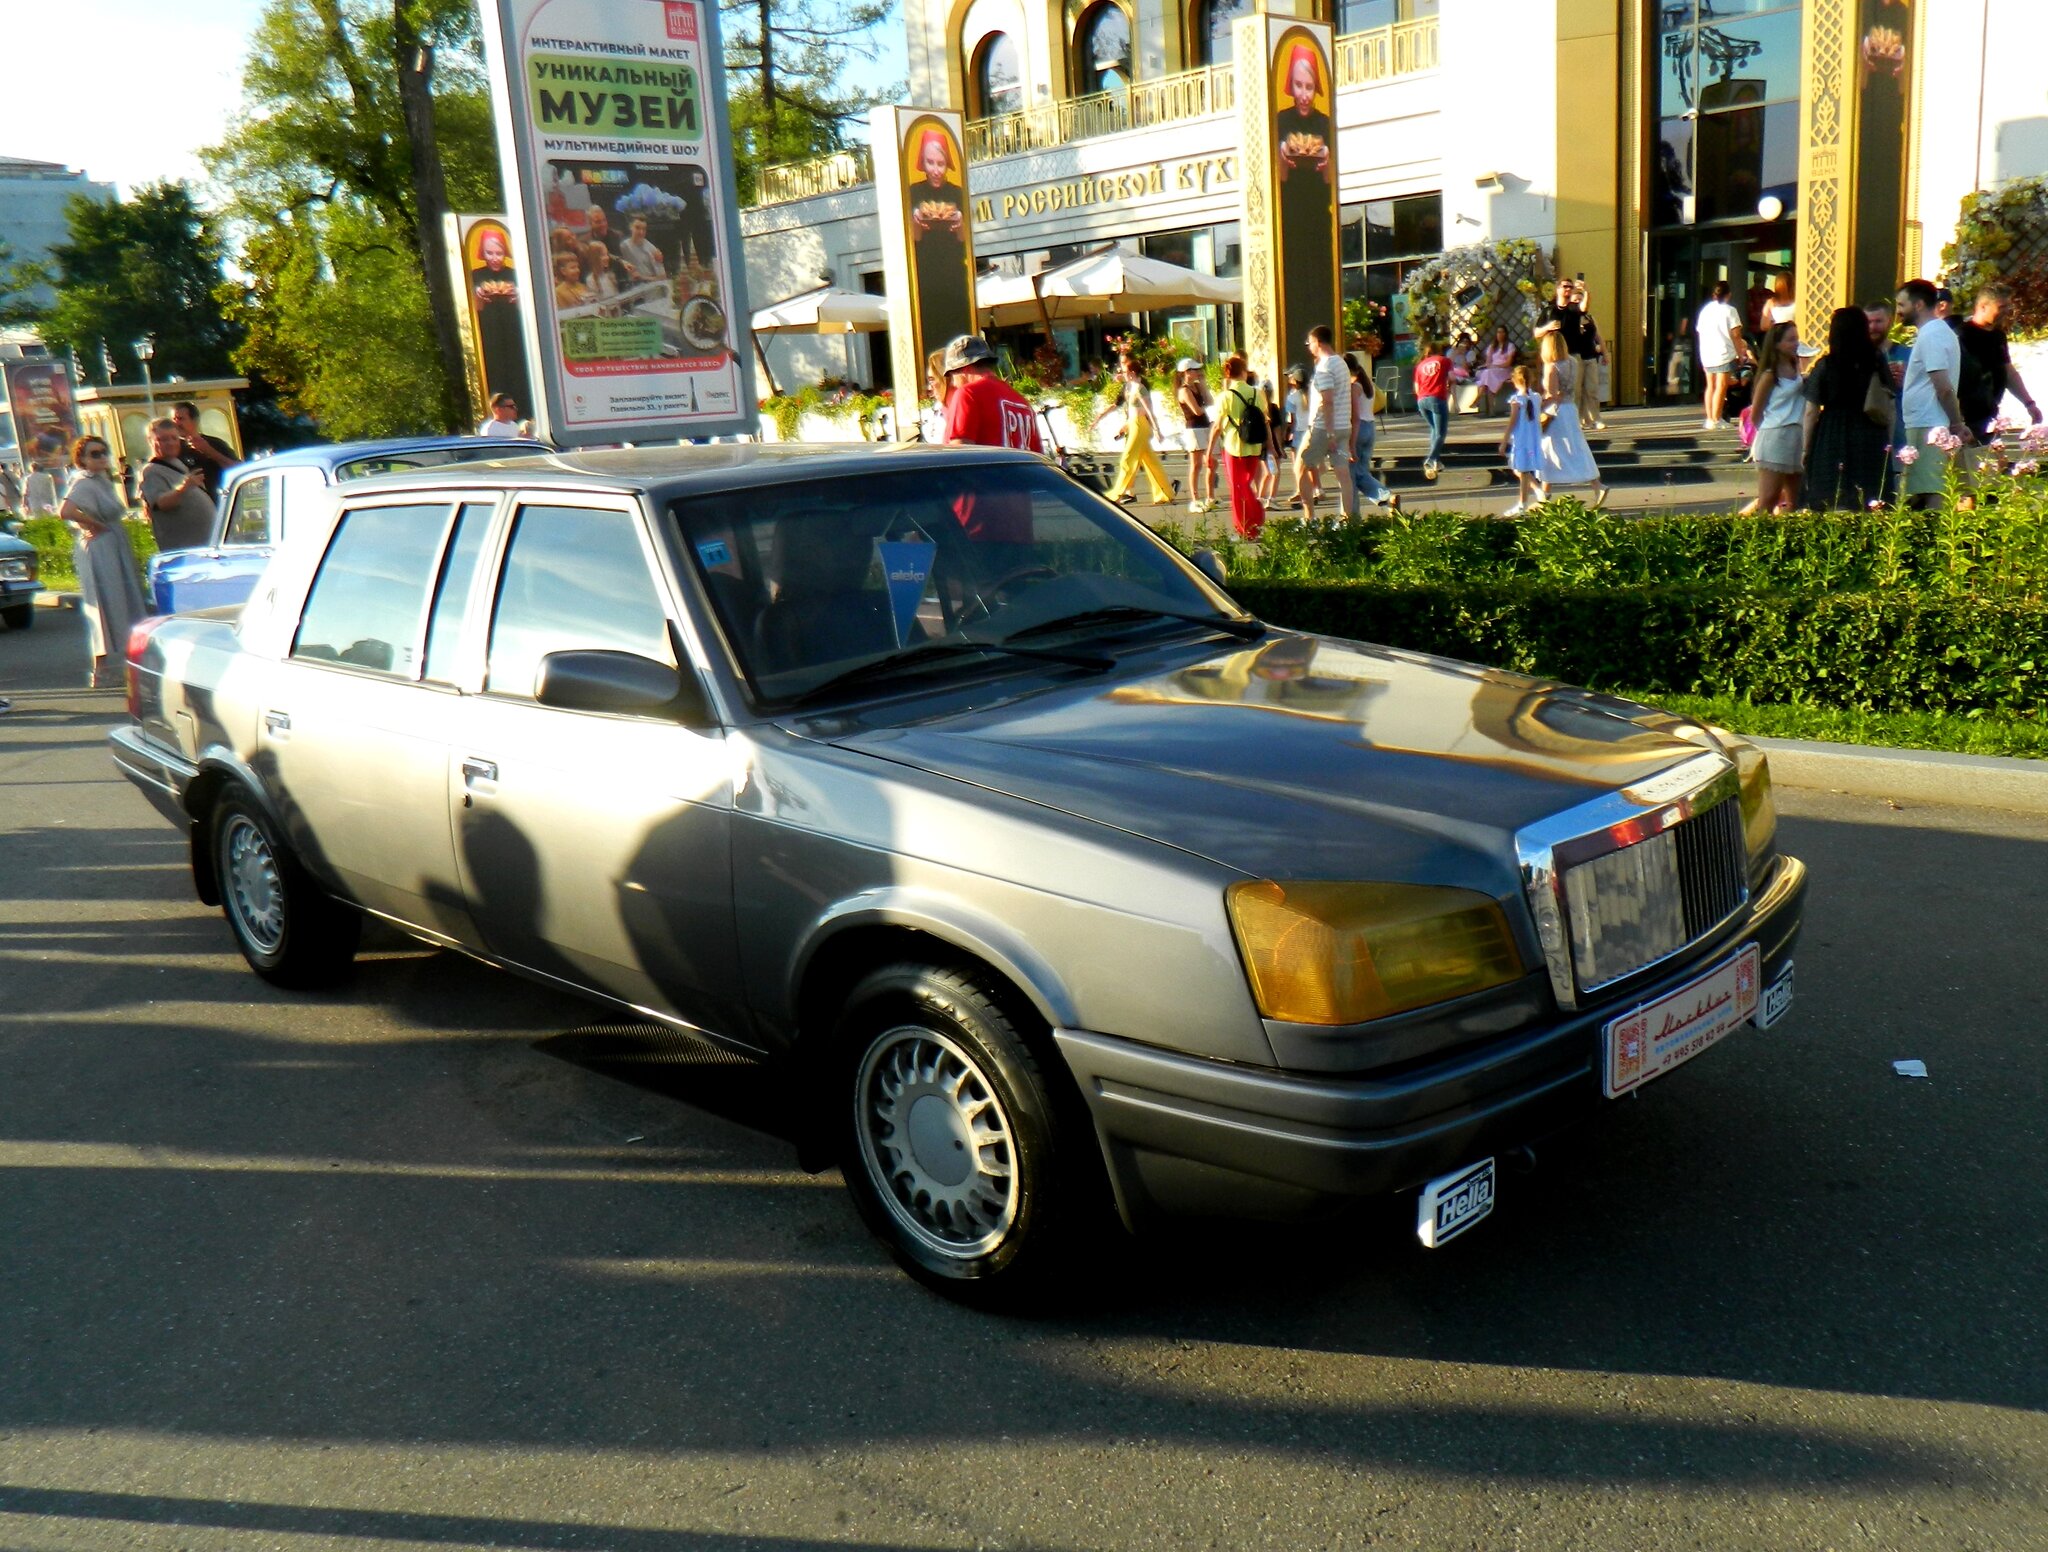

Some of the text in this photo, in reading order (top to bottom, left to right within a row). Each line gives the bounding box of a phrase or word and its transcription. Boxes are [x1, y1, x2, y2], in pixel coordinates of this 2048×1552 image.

[671, 26, 695, 36] ВДНХ
[531, 37, 690, 60] ИНТЕРАКТИВНЫЙ МАКЕТ
[534, 61, 693, 90] УНИКАЛЬНЫЙ
[539, 87, 697, 131] МУЗЕЙ
[544, 139, 700, 156] МУЛЬТИМЕДИЙНОЕ ШОУ
[1002, 162, 1166, 219] РОССИЙСКОЙ
[1440, 1180, 1489, 1227] Hella
